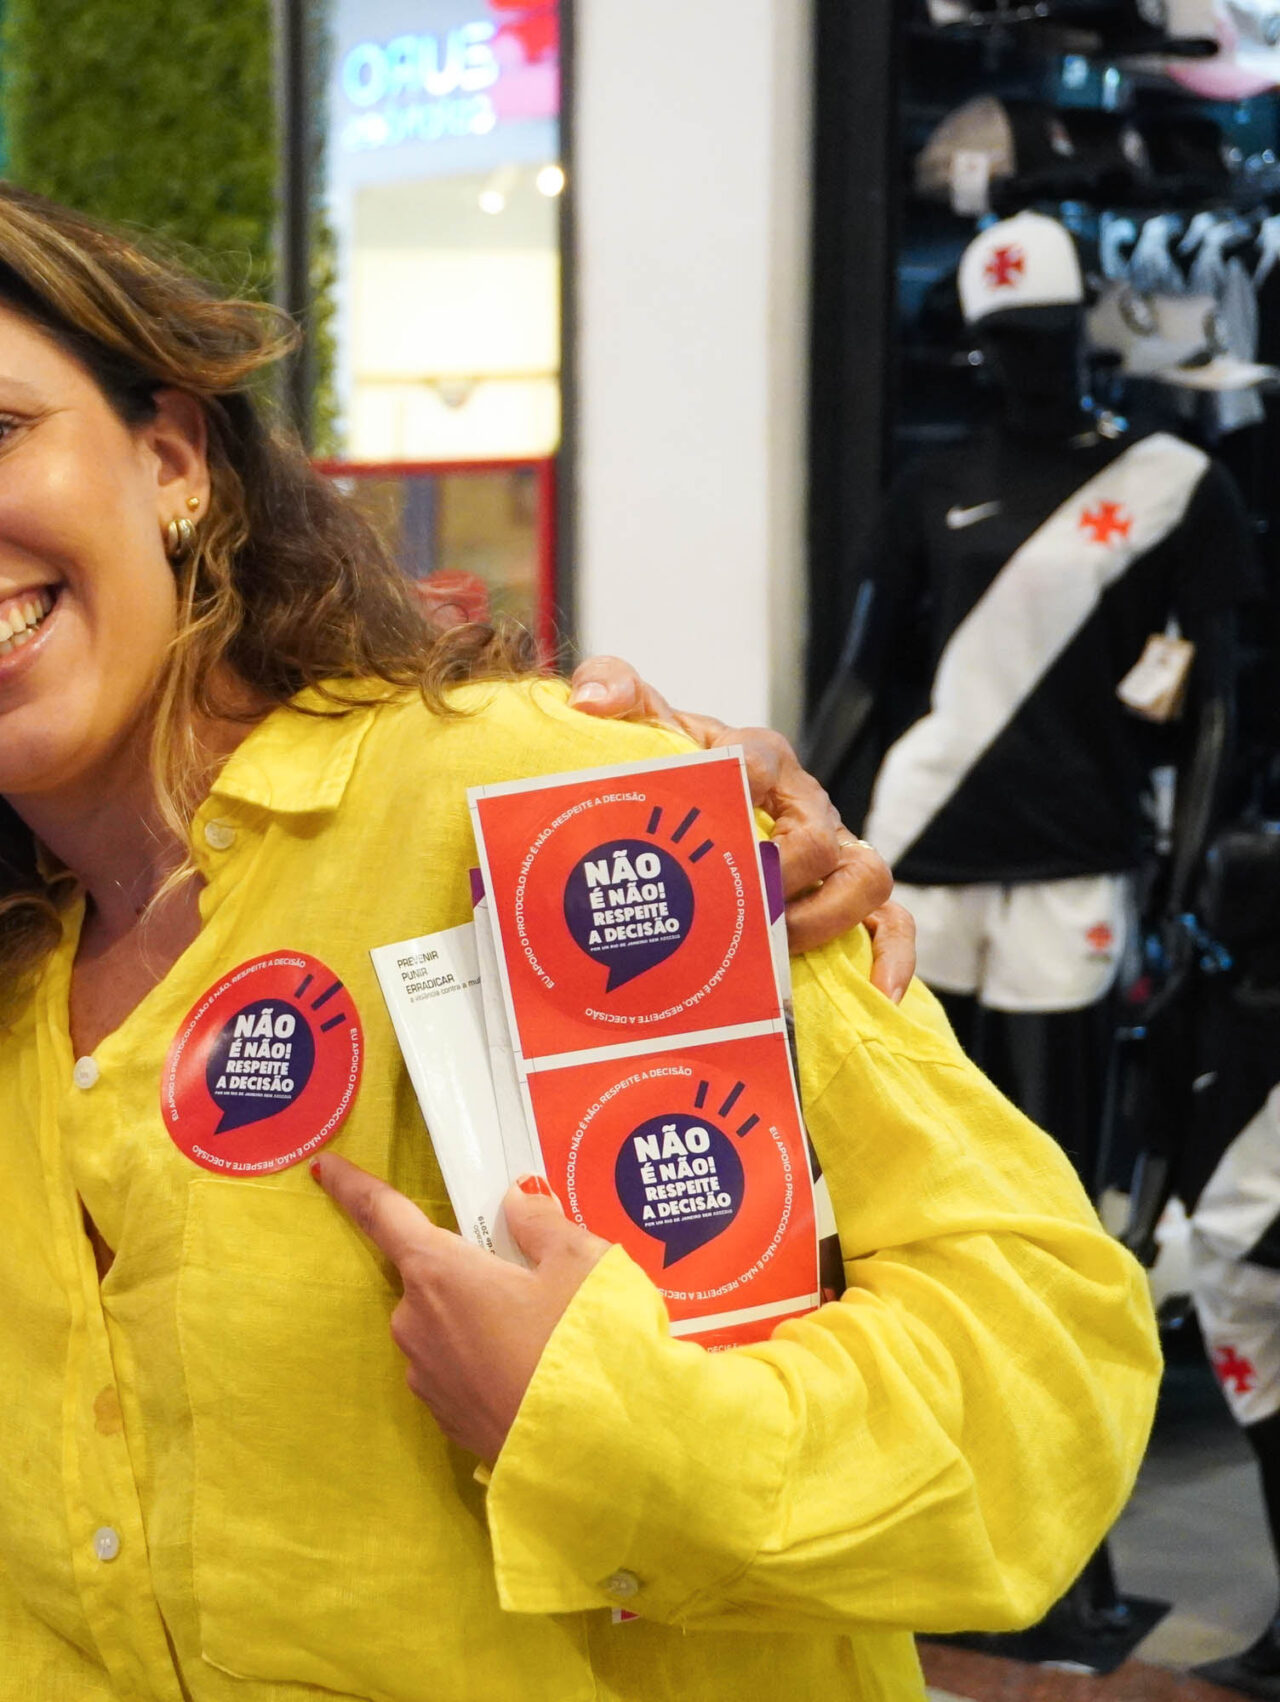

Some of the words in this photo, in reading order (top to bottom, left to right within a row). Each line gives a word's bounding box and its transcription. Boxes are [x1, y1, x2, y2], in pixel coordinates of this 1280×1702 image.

[595, 797, 602, 805] A
[602, 792, 646, 803] DECISÃO
[552, 800, 592, 829] RESPEITE
[521, 853, 534, 875] NÃO
[723, 851, 734, 865] EU
[584, 849, 661, 888] NÃO
[730, 867, 744, 897] APOIO
[590, 887, 605, 909] É
[608, 881, 666, 906] NÃO!
[737, 899, 744, 907] O
[515, 875, 527, 937] PROTOCOLO
[593, 901, 669, 926] RESPEITE
[589, 929, 602, 945] A
[604, 917, 680, 942] DECISÃO
[722, 908, 744, 967] PROTOCOLO
[521, 938, 529, 946] O
[397, 950, 439, 968] PREVENIR
[524, 946, 545, 974] APOIO
[401, 967, 428, 981] PUNIR
[406, 974, 455, 994] ERRADICAR
[541, 975, 555, 989] EU
[709, 967, 726, 986] NÃO
[234, 1008, 296, 1039] NÃO
[585, 1008, 627, 1024] DECISÃO
[629, 1016, 635, 1024] A
[638, 1004, 684, 1023] RESPEITE
[350, 1028, 357, 1041] EU
[229, 1038, 242, 1057] É
[244, 1038, 292, 1060] NÃO!
[351, 1042, 359, 1073] APOIO
[226, 1059, 289, 1075] RESPEITE
[649, 1066, 692, 1077] DECISÃO
[216, 1075, 226, 1089] A
[229, 1075, 294, 1093] DECISÃO
[349, 1074, 356, 1082] O
[600, 1074, 640, 1103] RESPEITE
[320, 1083, 354, 1136] PROTOCOLO
[303, 1134, 321, 1151] NÃO
[571, 1129, 584, 1151] NÃO
[769, 1126, 780, 1140] EU
[633, 1124, 710, 1163] NÃO
[192, 1145, 224, 1167] DECISÃO
[232, 1159, 274, 1171] RESPEITE
[776, 1141, 791, 1172] APOIO
[640, 1162, 657, 1184] É
[659, 1156, 716, 1181] NÃO!
[785, 1173, 792, 1182] O
[567, 1151, 580, 1213] PROTOCOLO
[645, 1176, 720, 1201] RESPEITE
[643, 1205, 656, 1220] A
[657, 1191, 731, 1217] DECISÃO
[774, 1182, 793, 1243] PROTOCOLO
[762, 1242, 777, 1262] NÃO
[660, 1288, 686, 1299] DECIS
[688, 1292, 694, 1300] A
[697, 1280, 739, 1299] RESPEITE
